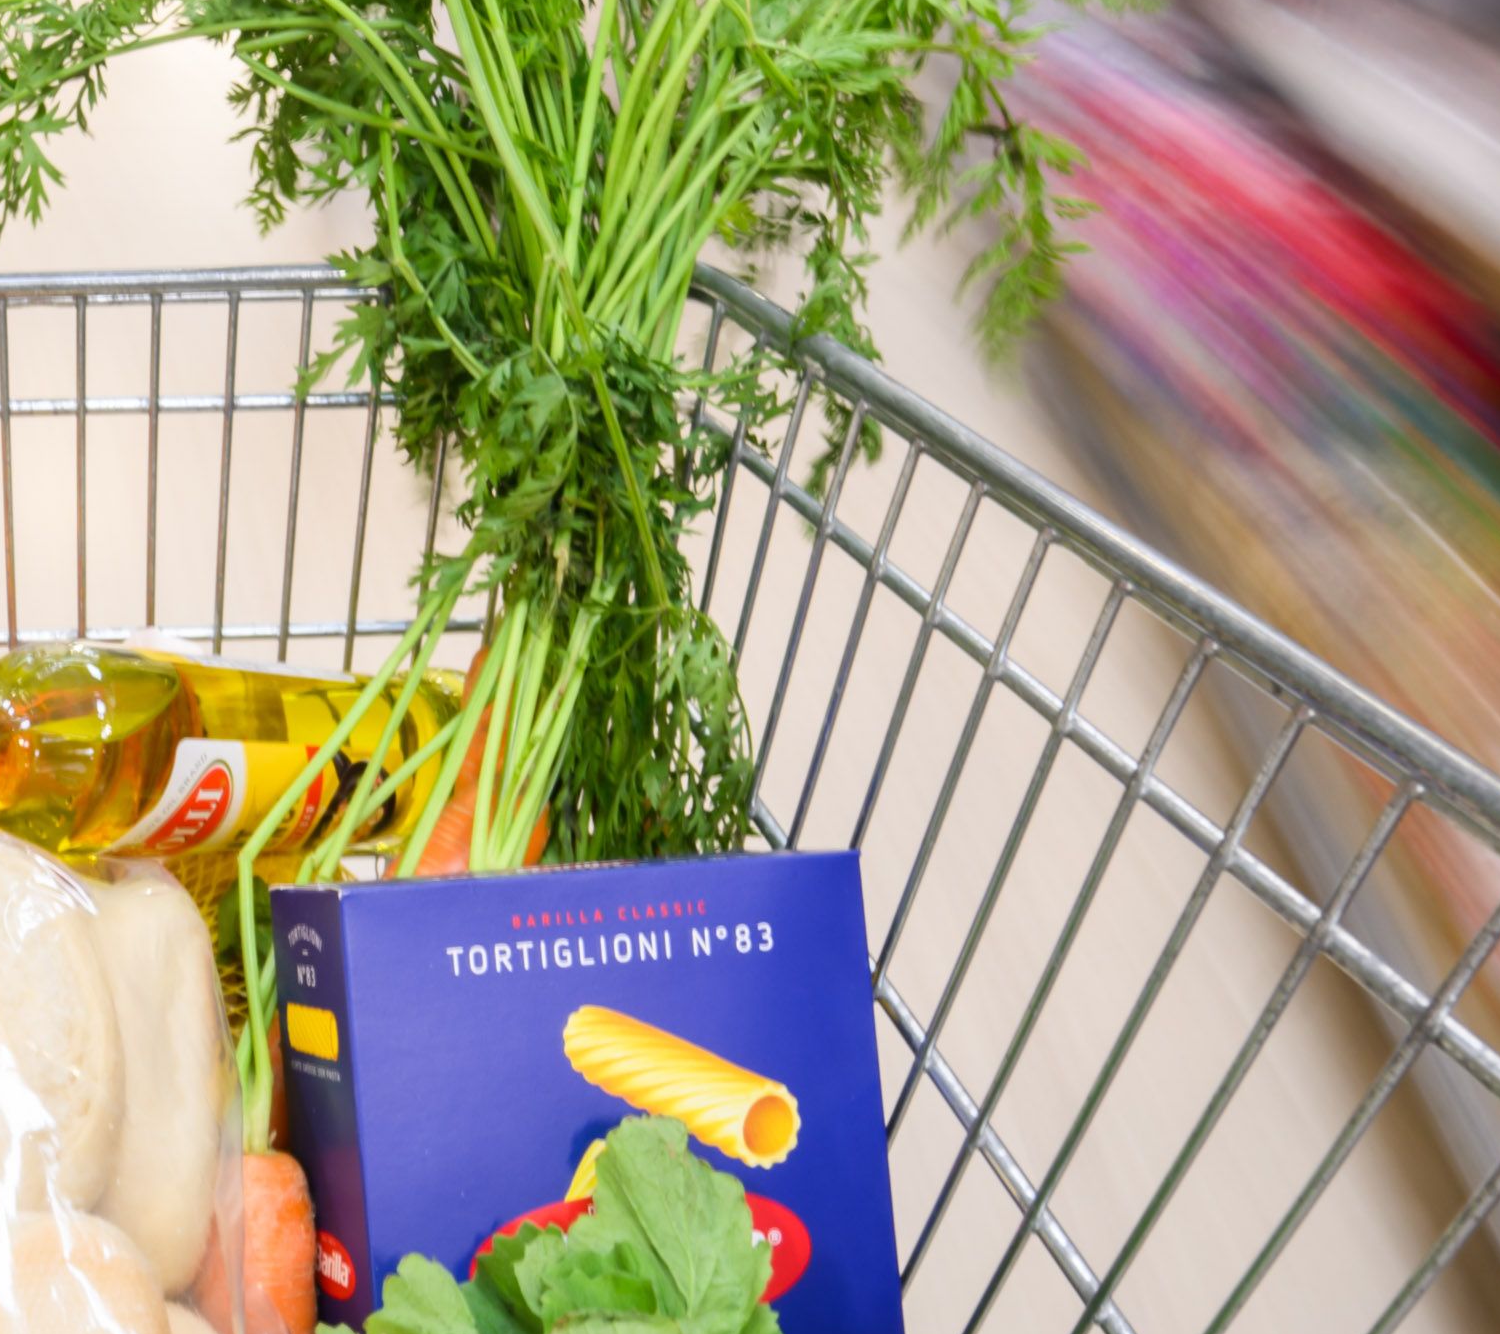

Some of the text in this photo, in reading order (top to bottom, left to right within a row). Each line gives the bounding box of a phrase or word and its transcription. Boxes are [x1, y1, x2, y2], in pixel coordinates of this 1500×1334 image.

[512, 899, 707, 930] BARILLA CLASSIC
[288, 923, 322, 953] TORTIGLIONI
[446, 930, 672, 976] TORTIGLIONI
